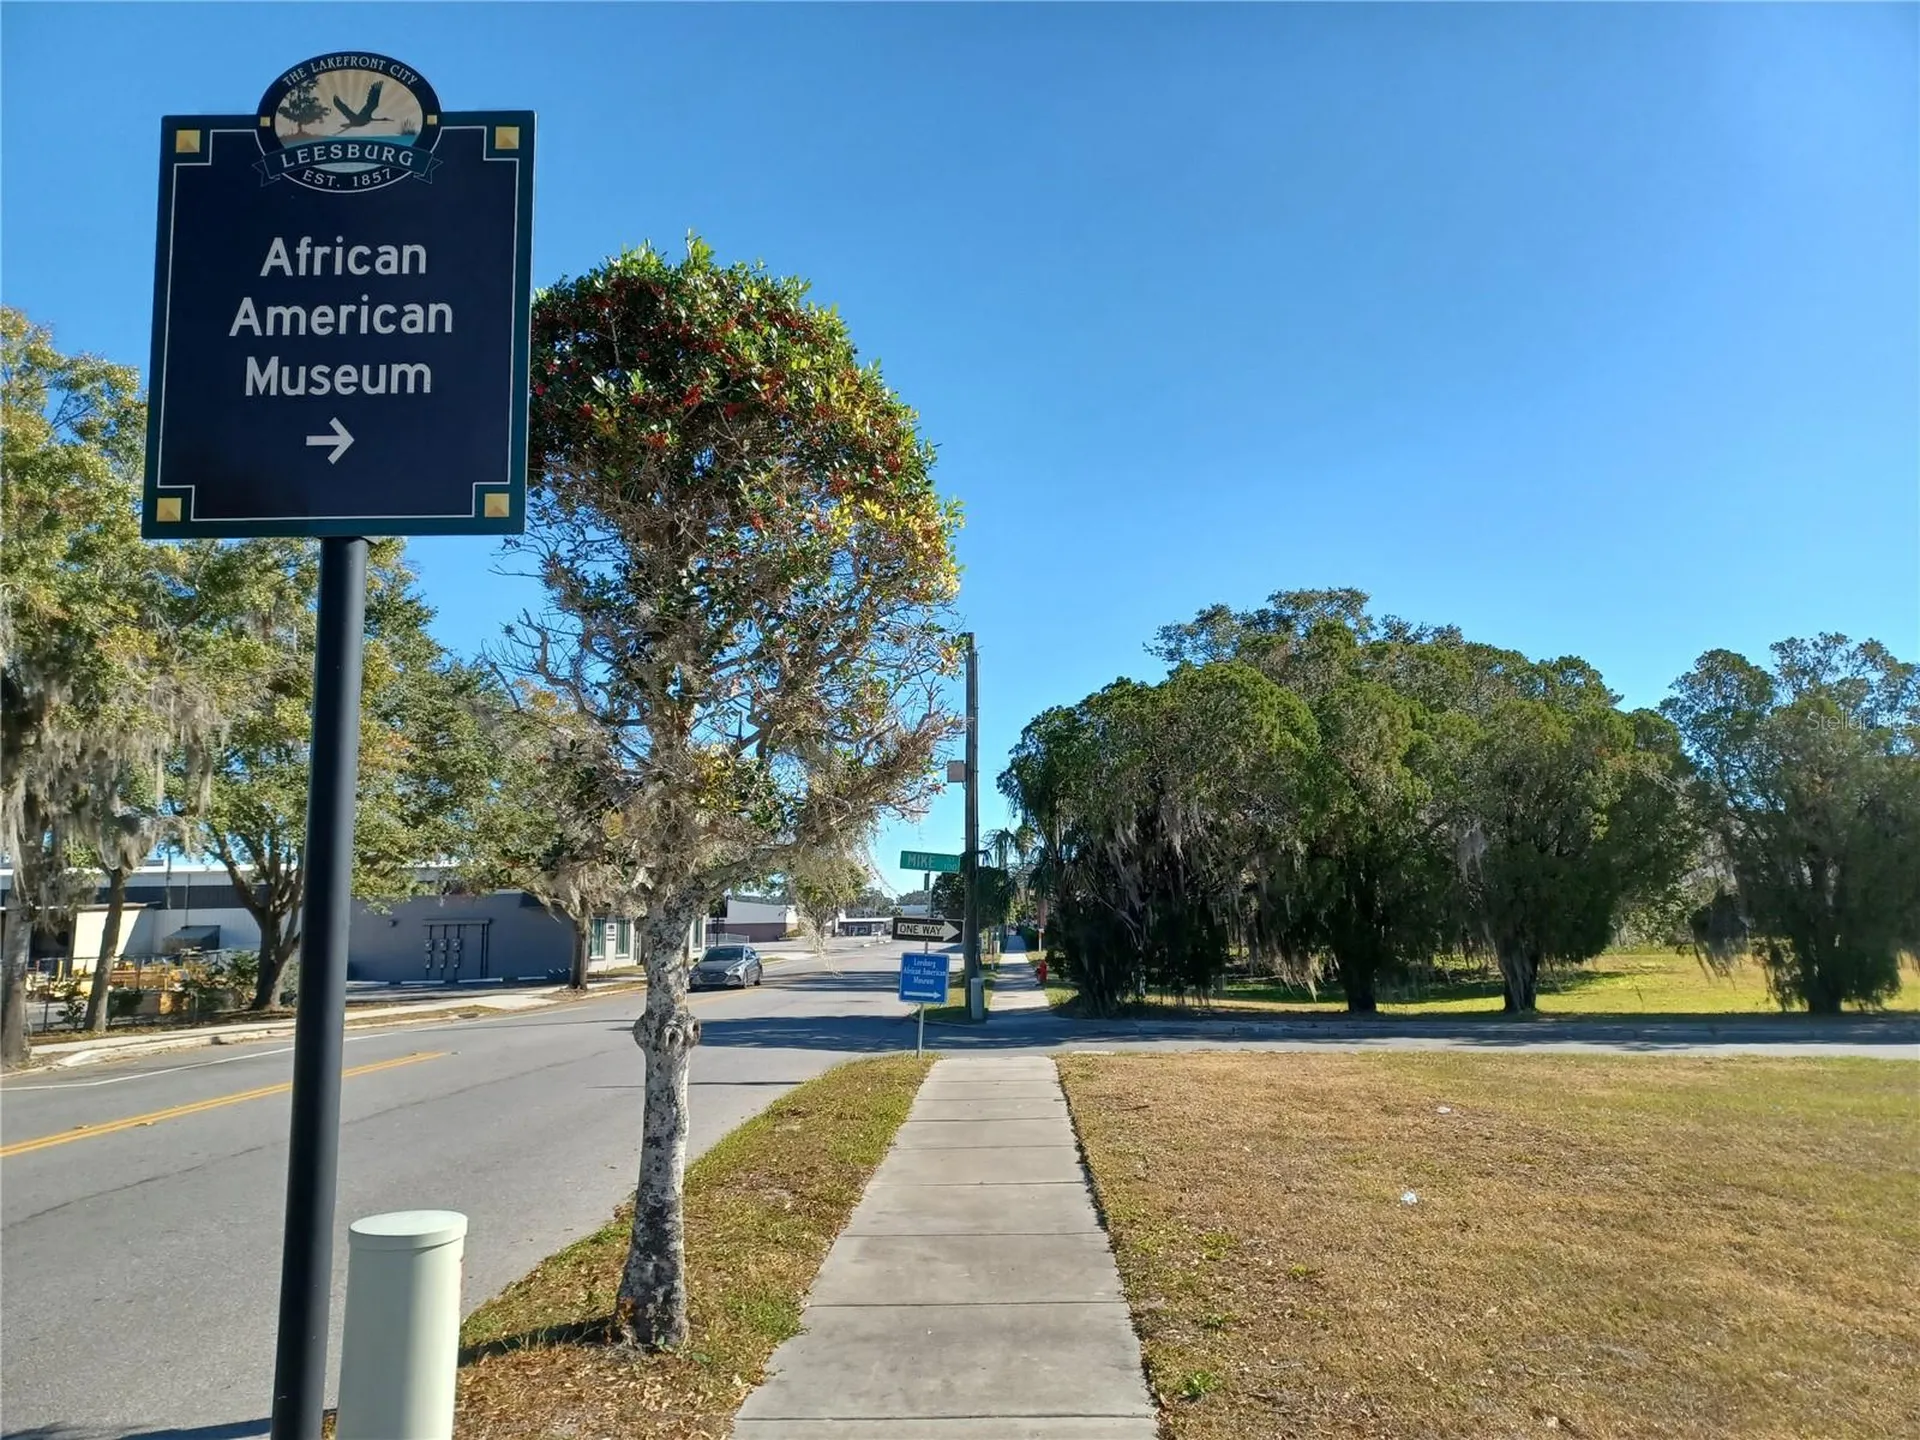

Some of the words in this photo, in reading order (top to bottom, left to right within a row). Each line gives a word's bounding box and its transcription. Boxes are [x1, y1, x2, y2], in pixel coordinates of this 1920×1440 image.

[283, 67, 308, 88] THE
[310, 55, 388, 74] LAKEFRONT
[389, 63, 420, 86] CITY
[279, 143, 415, 168] LEESBURG
[302, 169, 342, 188] EST.
[352, 168, 394, 187] 1857
[260, 235, 428, 277] African
[229, 294, 454, 337] American
[245, 356, 433, 397] Museum
[907, 853, 936, 869] MIKE
[899, 924, 920, 934] ONE
[921, 925, 943, 936] WAY
